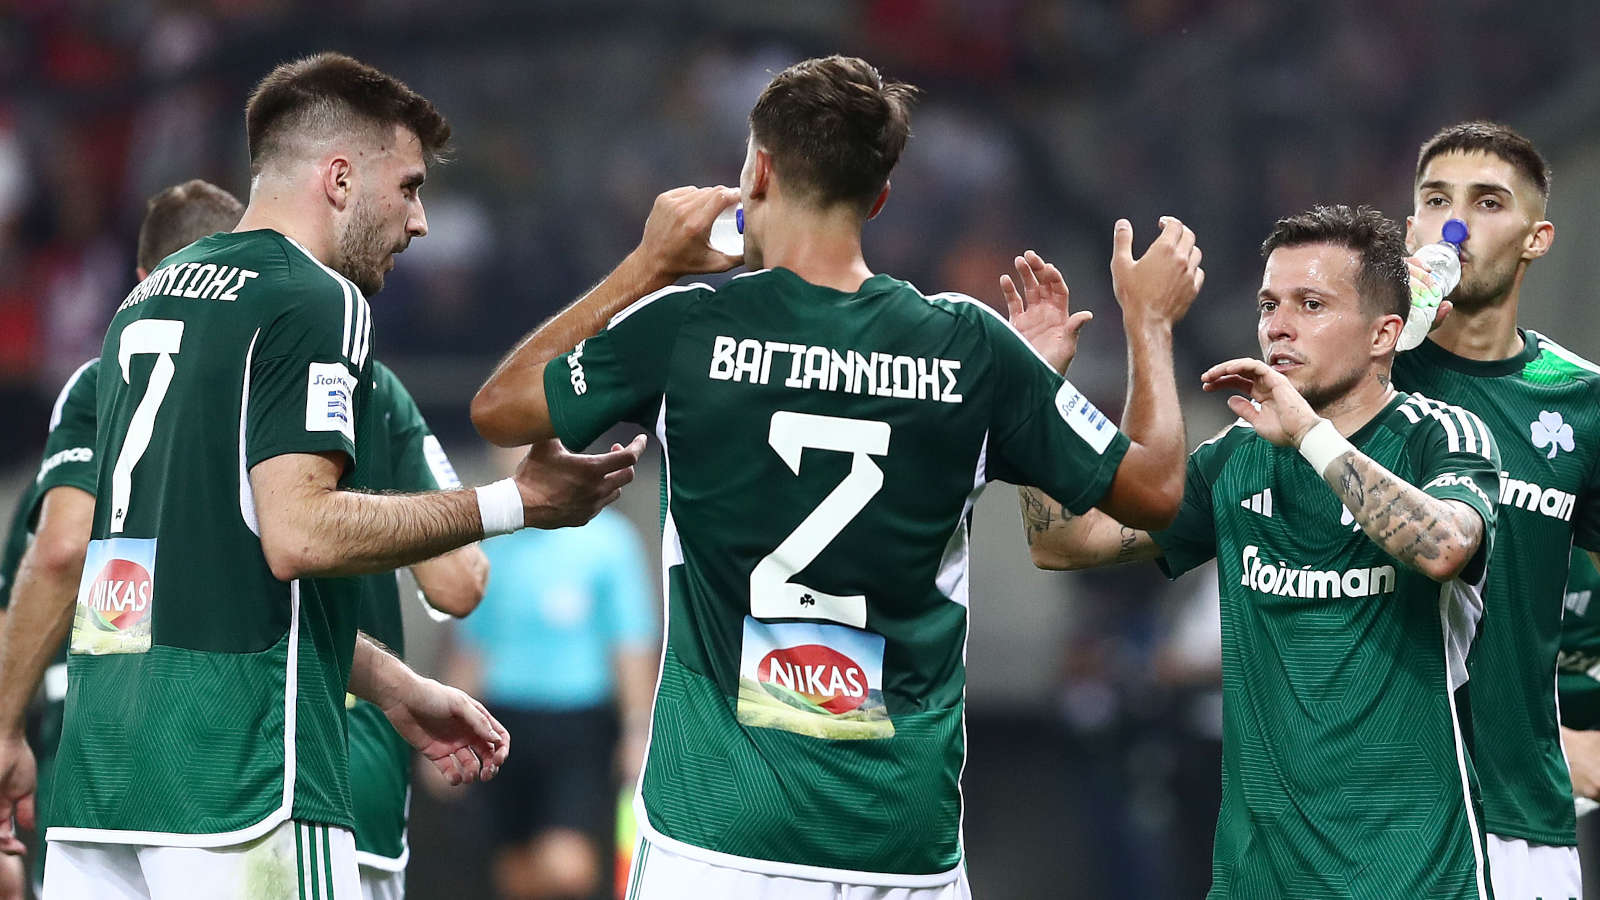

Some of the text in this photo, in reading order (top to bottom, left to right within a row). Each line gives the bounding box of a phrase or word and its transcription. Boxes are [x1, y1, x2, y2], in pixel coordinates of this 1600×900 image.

[111, 319, 185, 533] 7
[750, 410, 892, 629] 2
[91, 579, 150, 613] NIKAS
[1240, 544, 1396, 599] Stoiximan
[768, 656, 864, 698] NIKAS
